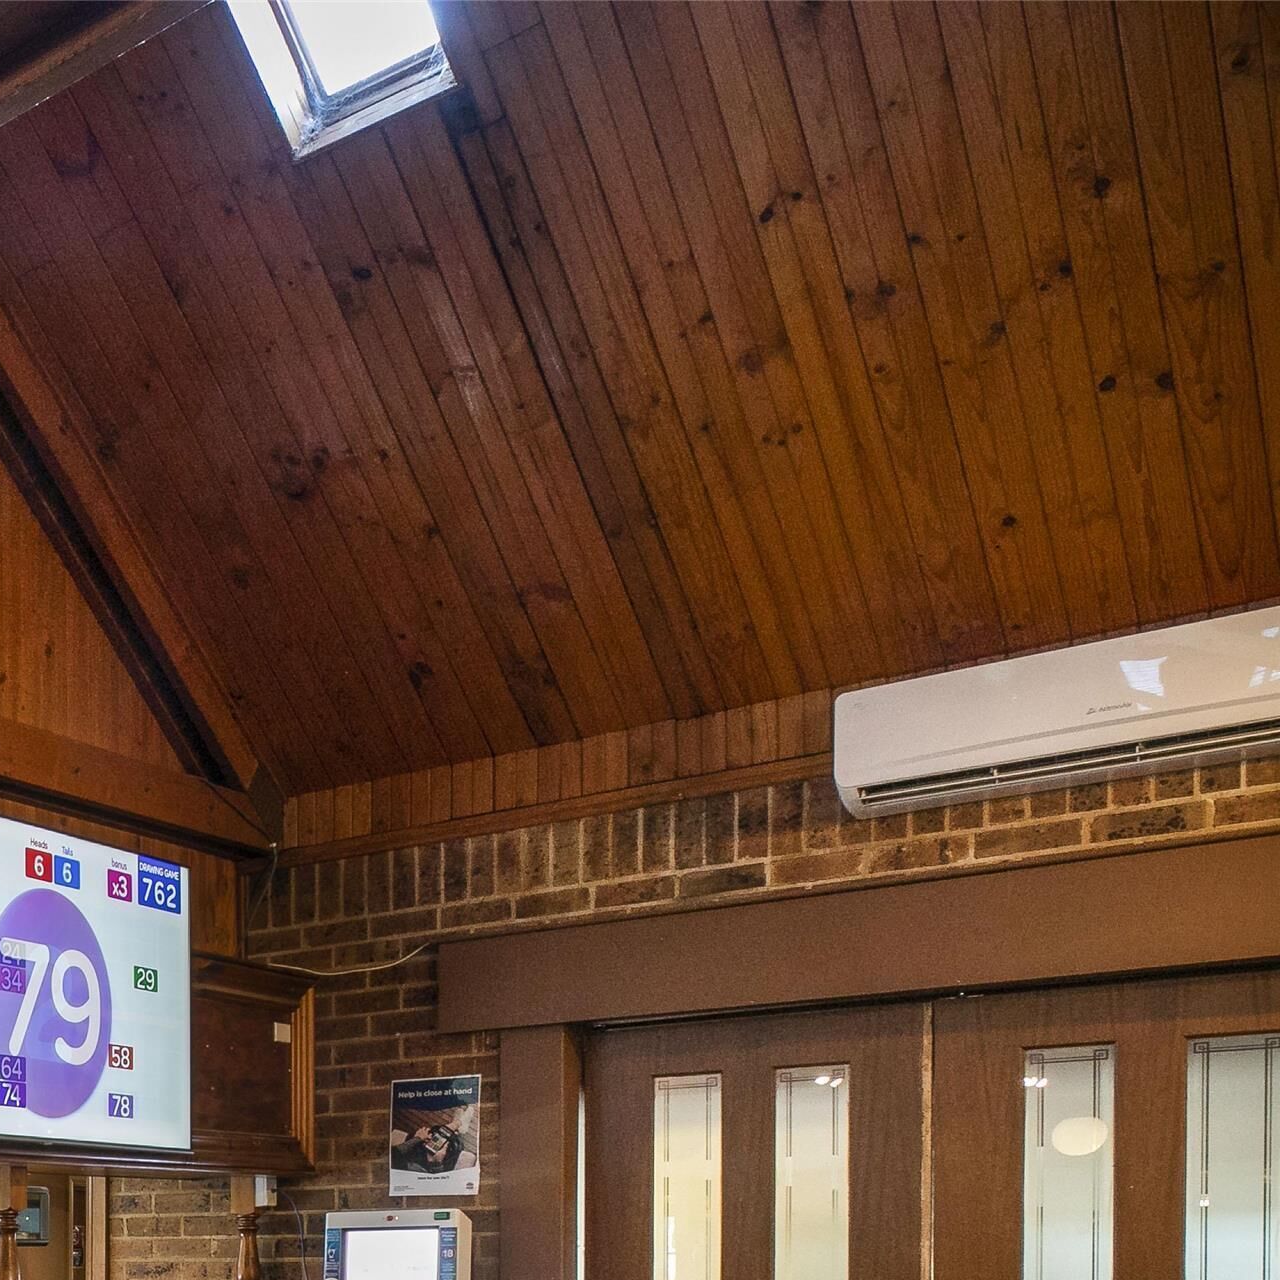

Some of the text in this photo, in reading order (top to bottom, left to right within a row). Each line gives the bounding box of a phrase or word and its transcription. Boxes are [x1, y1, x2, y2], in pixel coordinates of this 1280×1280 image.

[30, 837, 48, 850] Heads
[61, 845, 74, 857] Tails
[34, 855, 44, 876] 6
[62, 862, 72, 883] 6
[111, 858, 128, 870] bonus
[139, 861, 180, 881] DRAWING GAME
[112, 875, 128, 898] x3
[142, 877, 176, 909] 762
[1, 968, 23, 992] 34
[137, 968, 155, 990] 29
[0, 937, 101, 1066] 79
[112, 1046, 130, 1068] 58
[1, 1057, 23, 1079] 64
[2, 1083, 21, 1107] 74
[398, 1091, 415, 1099] Help
[423, 1089, 443, 1097] close
[453, 1087, 473, 1095] hand
[112, 1096, 130, 1117] 78
